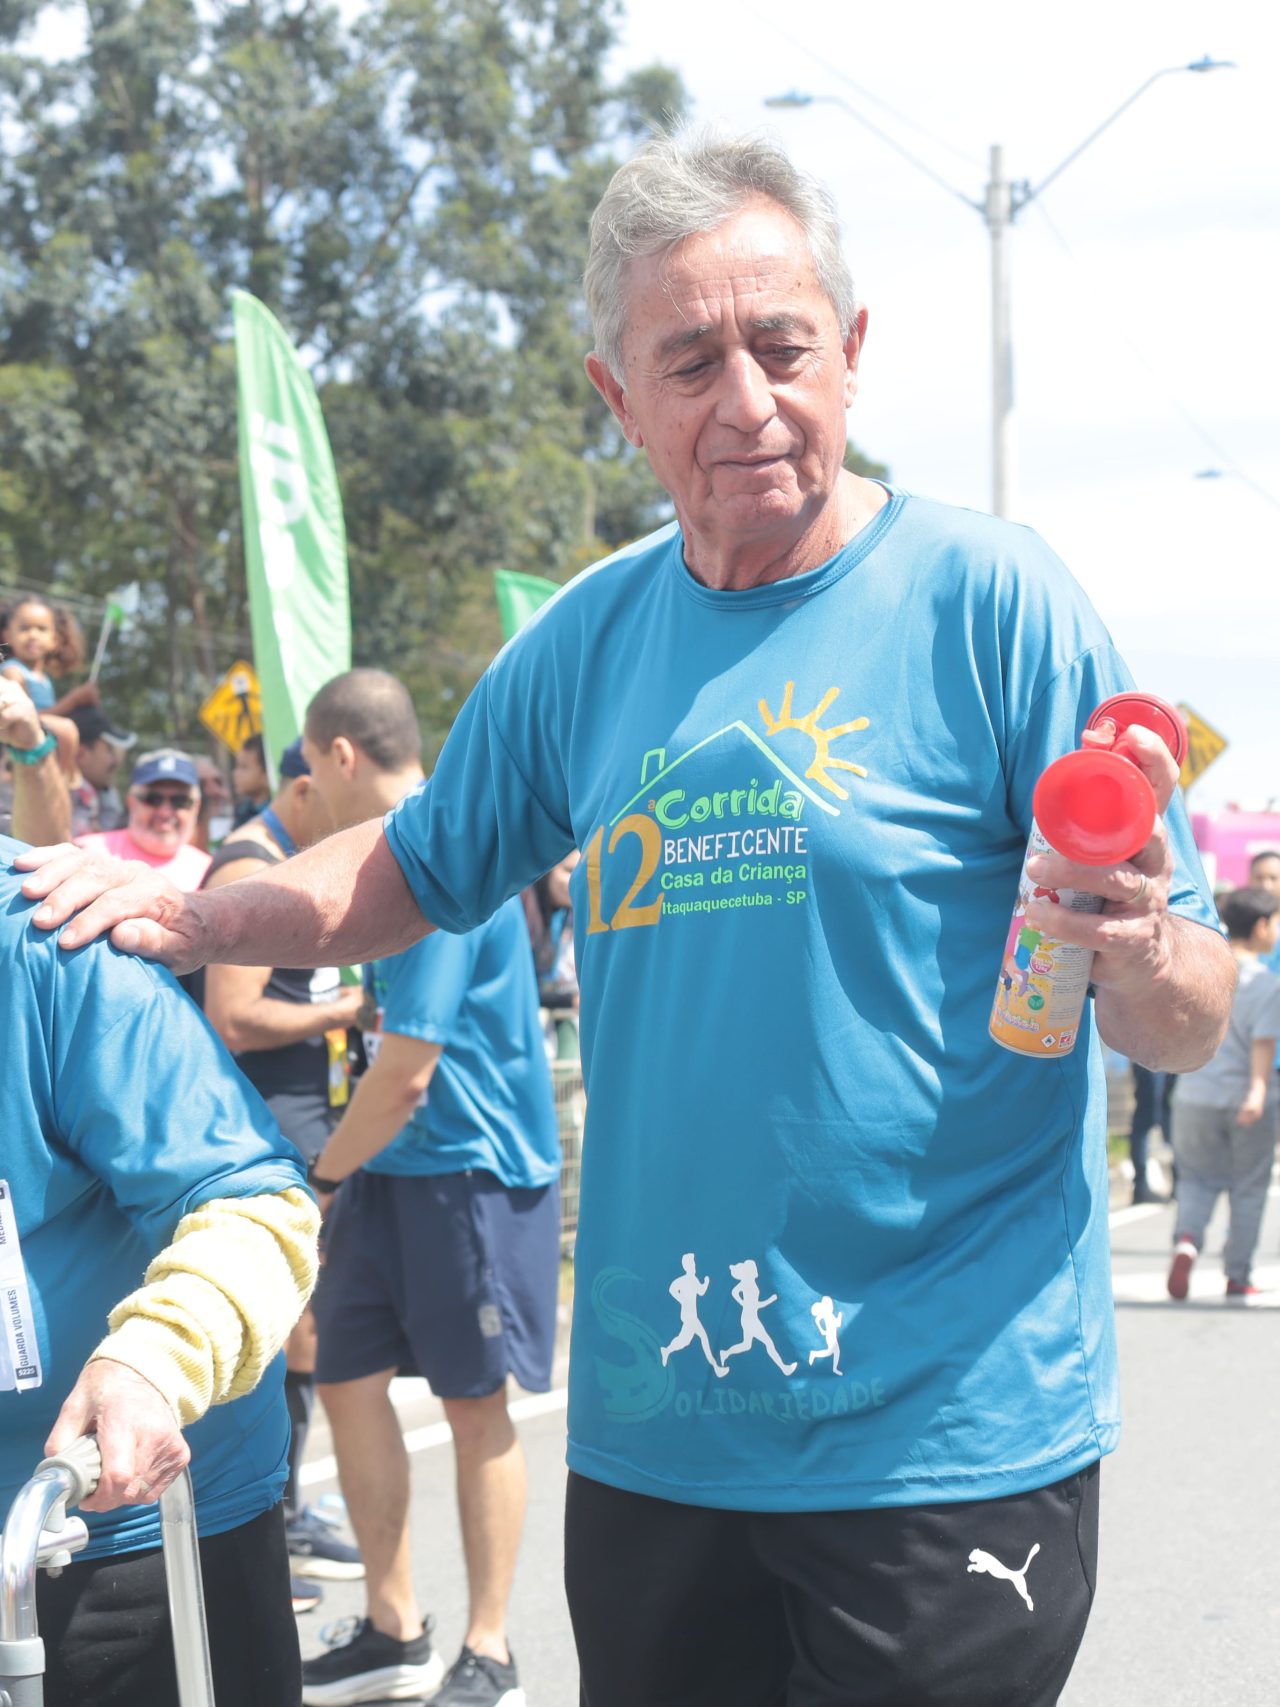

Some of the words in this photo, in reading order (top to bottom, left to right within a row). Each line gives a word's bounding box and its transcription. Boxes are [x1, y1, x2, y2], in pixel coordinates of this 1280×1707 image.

[655, 778, 805, 830] Corrida
[663, 826, 809, 865] BENEFICENTE
[660, 870, 704, 890] Casa
[711, 867, 733, 885] da
[738, 863, 807, 884] Criança
[661, 893, 773, 916] Itaquaquecetuba
[786, 891, 807, 904] SP
[7, 1289, 22, 1329] VOLUMES
[17, 1332, 29, 1367] GUARDA
